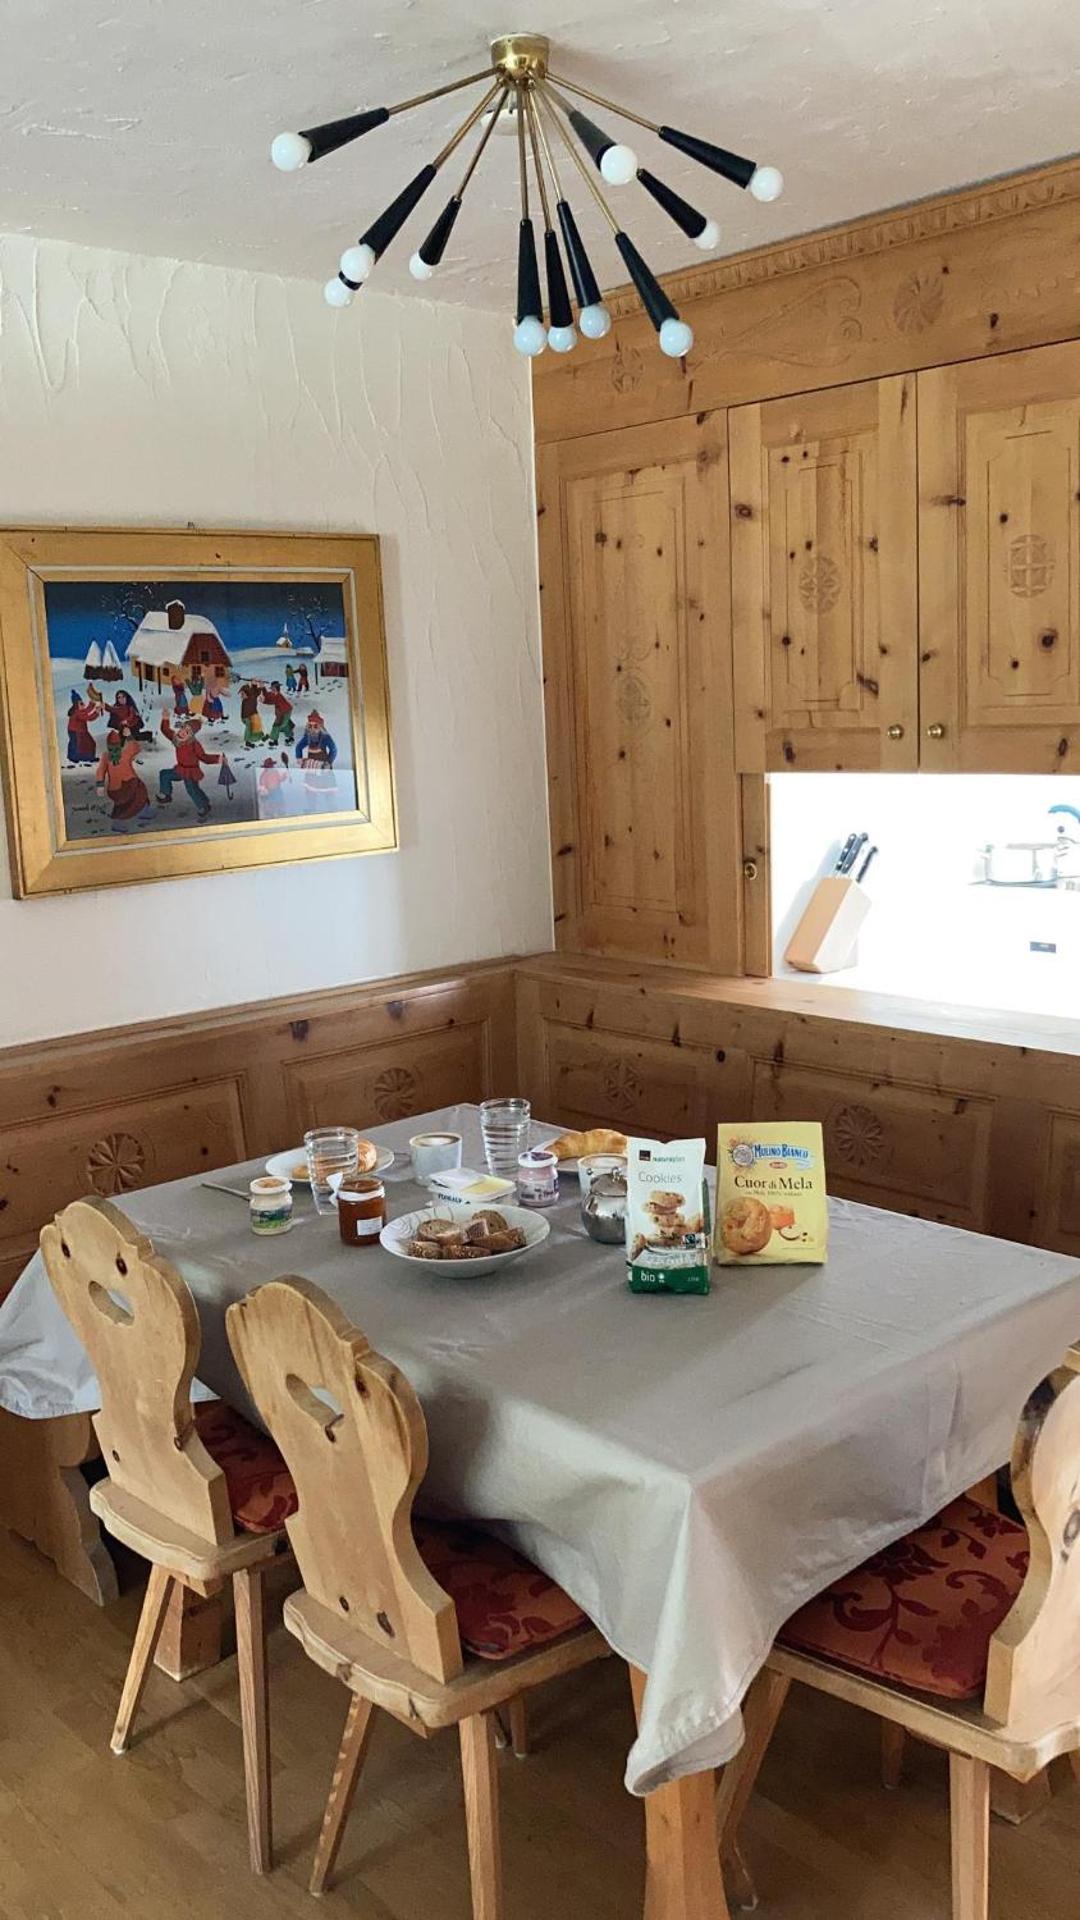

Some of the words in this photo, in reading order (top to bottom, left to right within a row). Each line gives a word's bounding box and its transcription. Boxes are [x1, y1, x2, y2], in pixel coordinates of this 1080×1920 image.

[638, 1170, 682, 1185] Cookies
[734, 1175, 767, 1189] Cuor
[768, 1179, 777, 1190] di
[779, 1176, 813, 1190] Mela
[640, 1270, 656, 1283] bio
